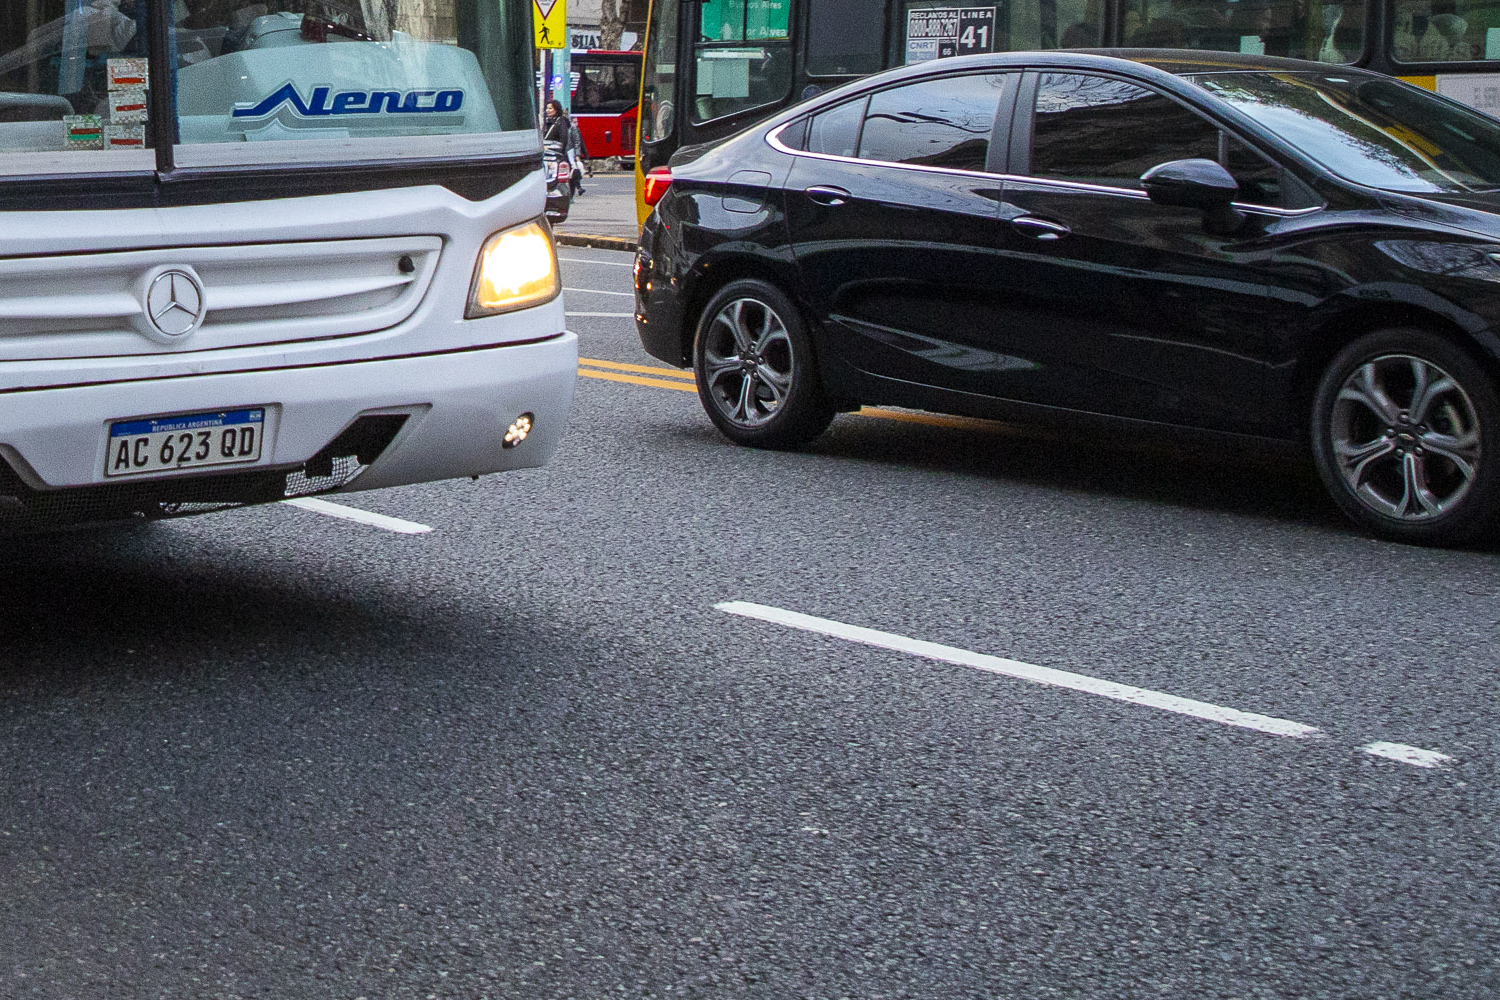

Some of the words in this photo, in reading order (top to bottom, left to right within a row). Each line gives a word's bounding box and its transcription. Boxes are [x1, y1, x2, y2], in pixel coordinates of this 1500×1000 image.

[961, 11, 992, 19] LINEA
[960, 25, 988, 48] 41
[909, 41, 935, 50] CNRT
[232, 82, 464, 118] Alenco
[187, 419, 223, 428] ARGENTINA
[114, 437, 149, 469] AC
[159, 431, 211, 464] 623
[220, 426, 255, 457] QD
